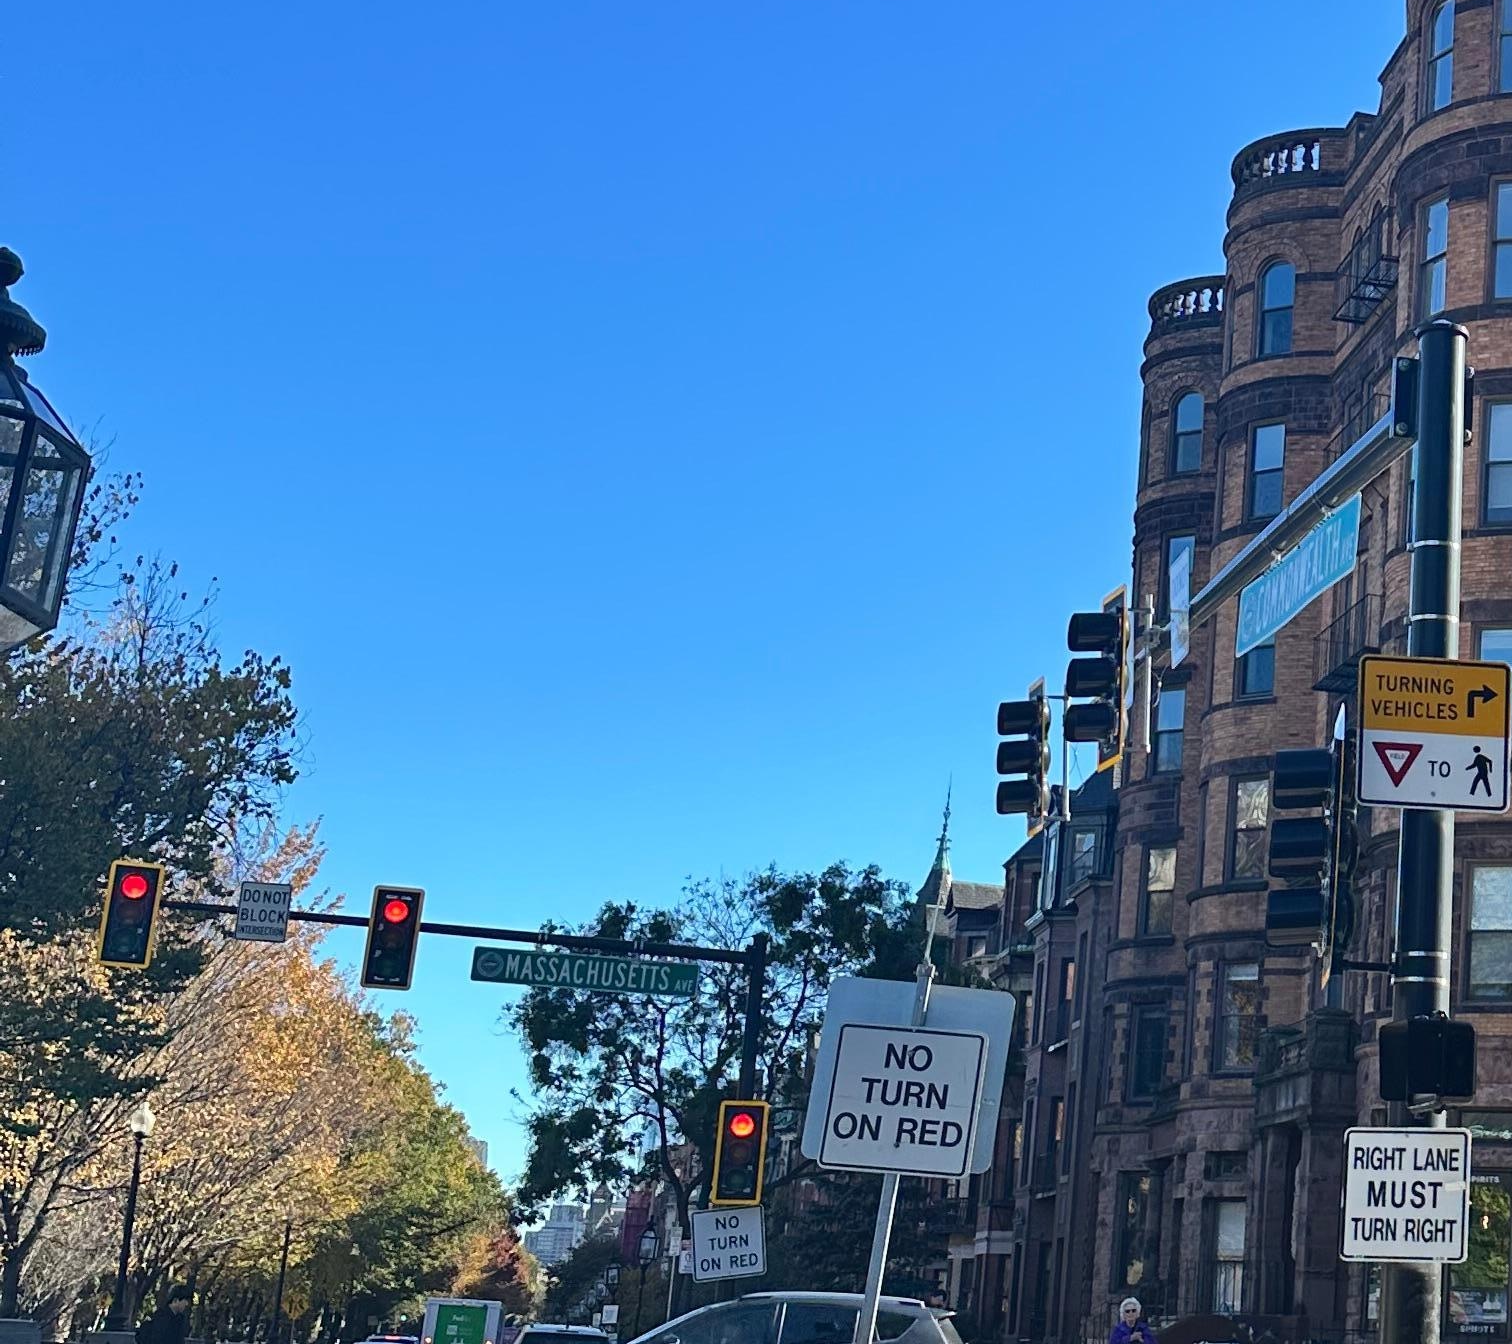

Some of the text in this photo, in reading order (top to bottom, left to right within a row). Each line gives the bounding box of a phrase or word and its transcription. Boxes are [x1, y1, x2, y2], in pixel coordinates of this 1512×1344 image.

[1256, 518, 1342, 634] COMMONWEALTH
[1376, 674, 1454, 696] TURNING
[1371, 699, 1458, 720] VEHICLES
[1428, 760, 1451, 778] TO
[243, 889, 289, 905] DO NOT
[240, 908, 286, 924] BLOCK
[504, 953, 694, 993] MASSACHUSETTS AVE
[884, 1043, 933, 1072] NO
[861, 1077, 949, 1110] TURN
[833, 1112, 963, 1148] ON RED
[1353, 1146, 1460, 1172] RIGHT LANE
[1367, 1180, 1443, 1209] MUST
[715, 1215, 739, 1231] NO
[1351, 1217, 1457, 1243] TURN RIGHT
[708, 1234, 749, 1251] TURN
[700, 1253, 759, 1272] ON RED
